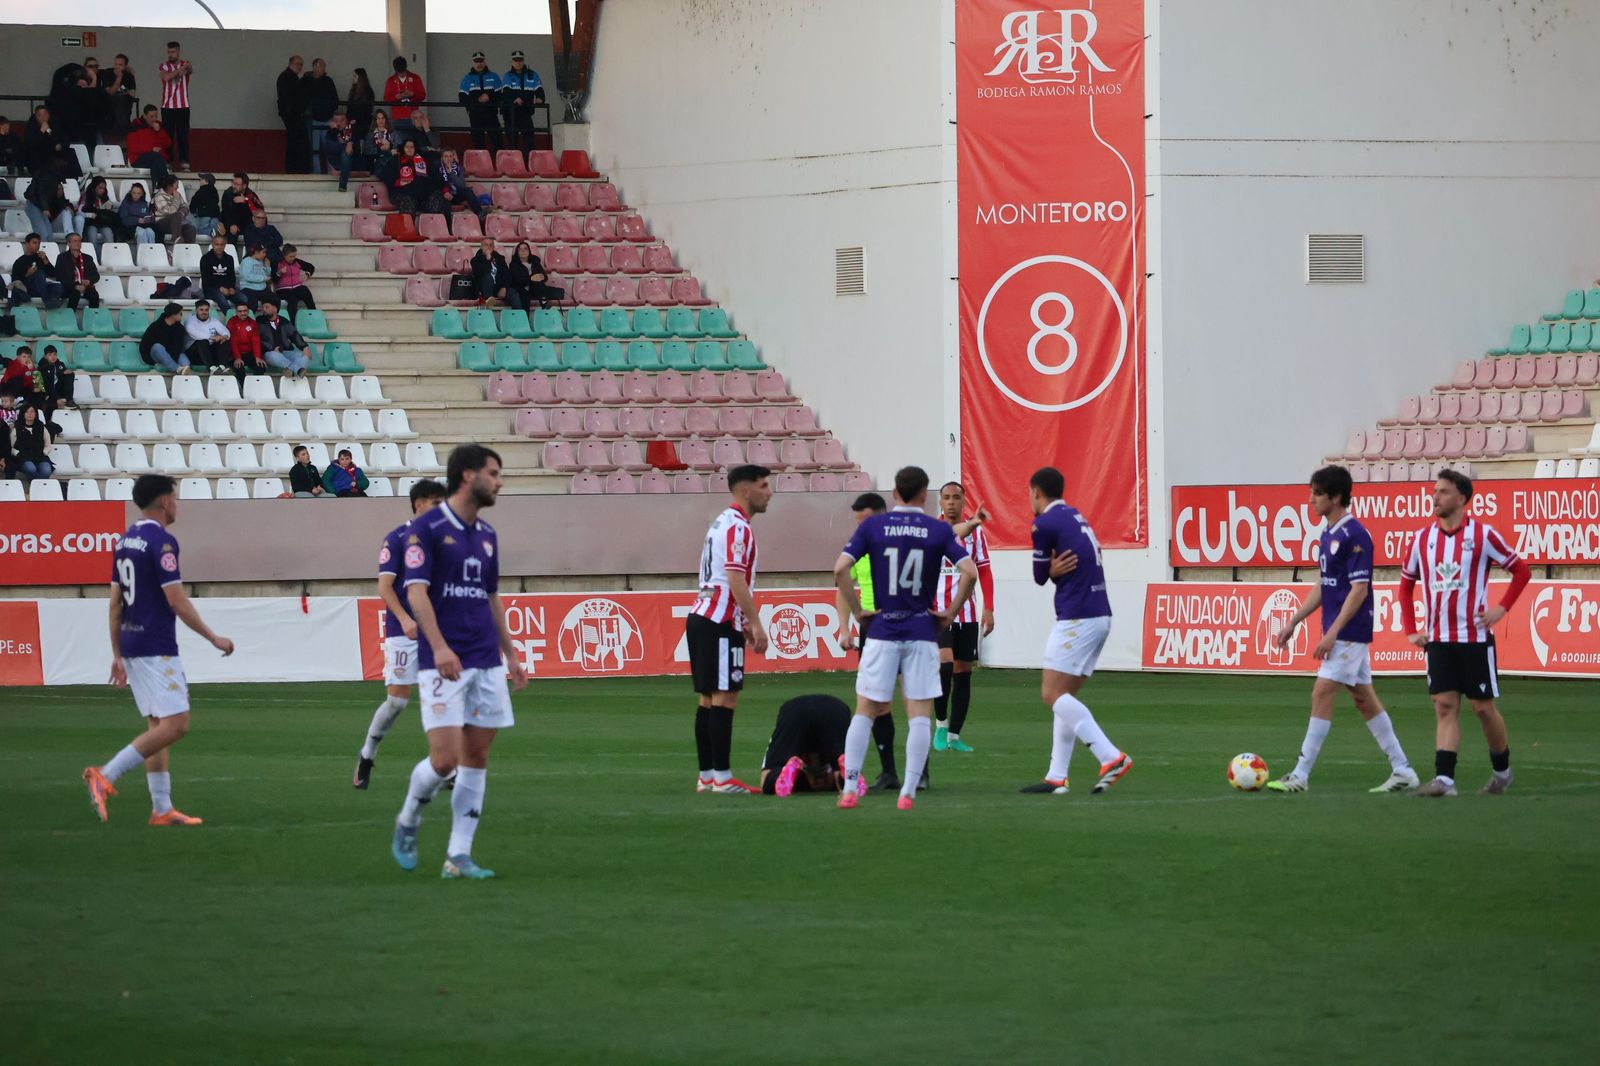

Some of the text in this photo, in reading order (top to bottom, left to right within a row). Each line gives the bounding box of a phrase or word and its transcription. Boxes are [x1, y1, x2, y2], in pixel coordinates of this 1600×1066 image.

[977, 83, 1122, 99] BODEGA RAMON RAMOS
[976, 200, 1127, 225] MONTETORO
[1027, 292, 1078, 375] 8
[1513, 482, 1600, 520] FUNDACIÓ
[883, 525, 929, 539] TAVARES
[1513, 523, 1600, 560] ZAMORAC
[883, 547, 924, 596] 14
[1155, 588, 1252, 625] FUNDACIÓN
[395, 650, 408, 667] 10
[730, 647, 744, 668] 10
[1153, 628, 1250, 666] ZAMORACF
[1374, 651, 1412, 661] GOODLIFE
[432, 677, 444, 697] 2
